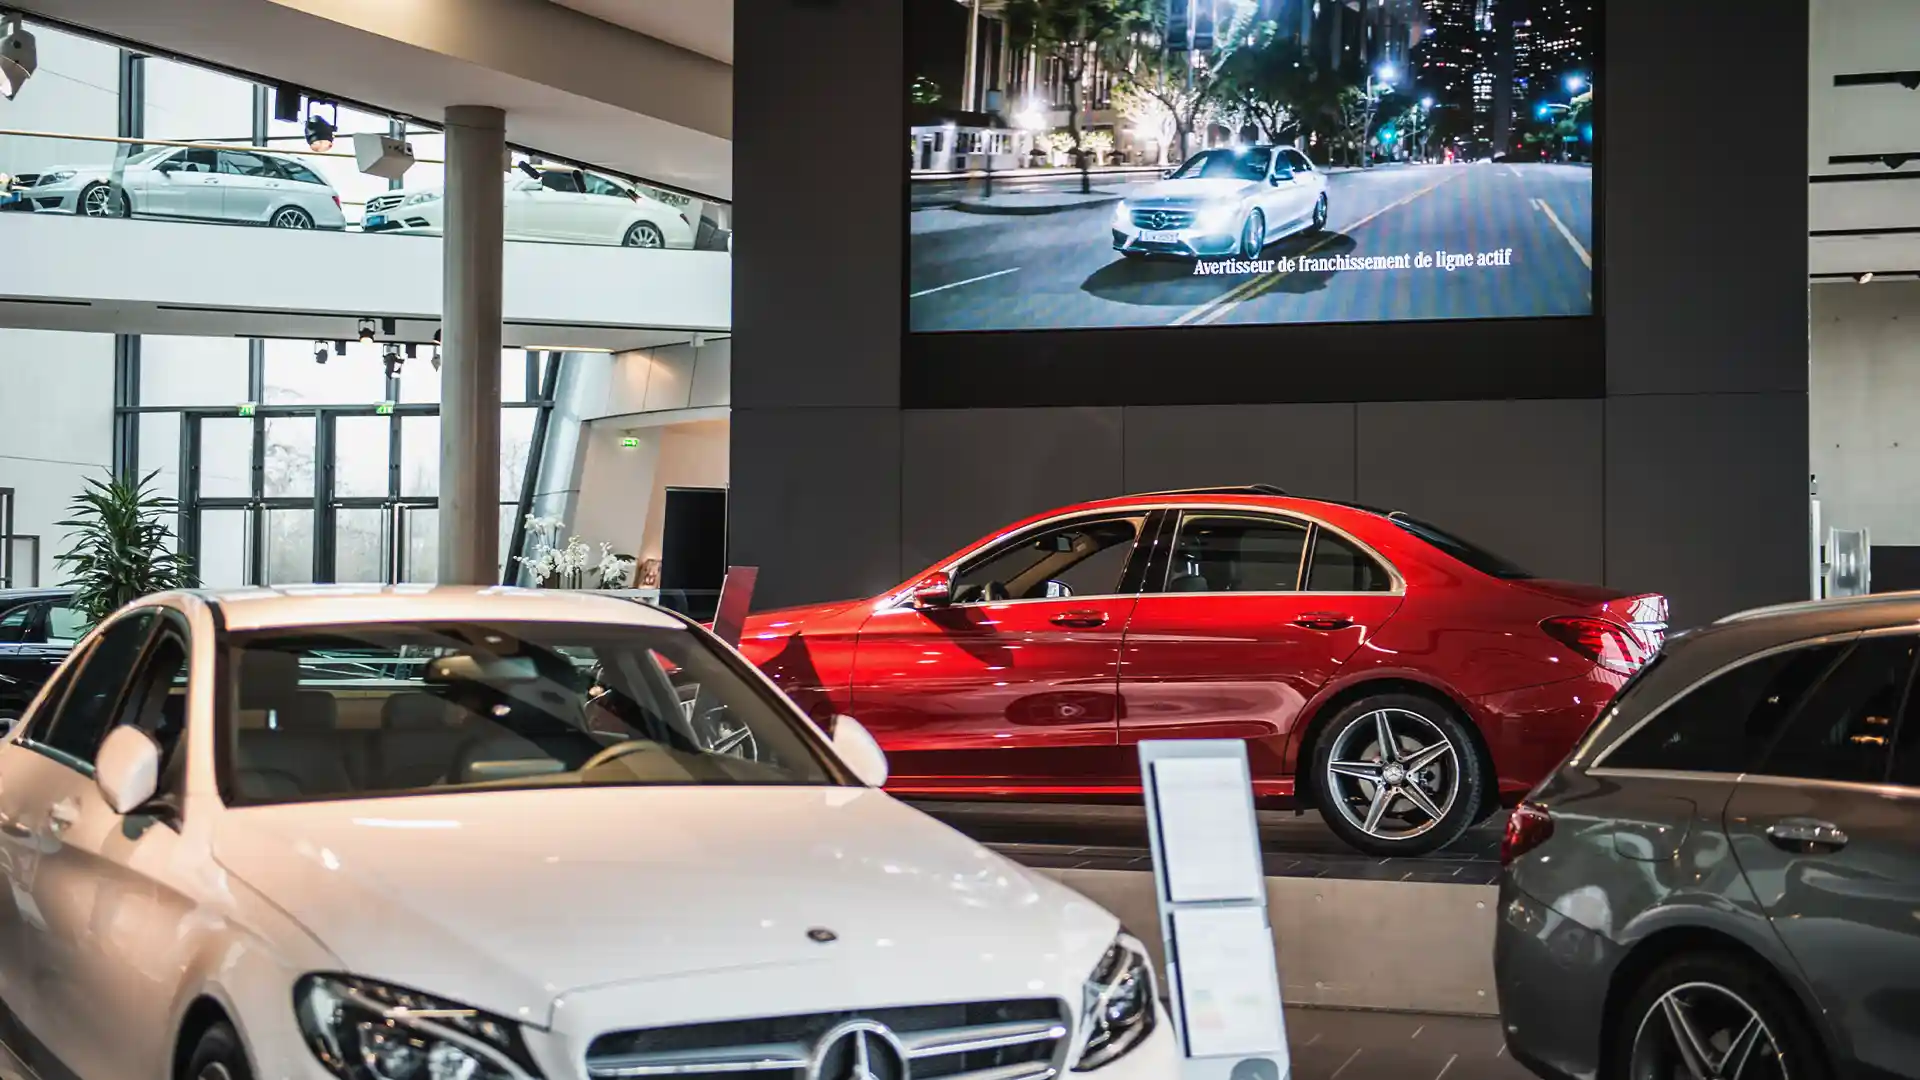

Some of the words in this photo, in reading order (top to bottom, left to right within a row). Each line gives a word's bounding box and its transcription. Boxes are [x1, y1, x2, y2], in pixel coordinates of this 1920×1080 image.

[1193, 258, 1274, 275] Avertisseur
[1278, 256, 1295, 272] de
[1299, 254, 1410, 272] franchissement
[1414, 251, 1433, 268] de
[1436, 250, 1473, 271] ligne
[1477, 248, 1512, 266] actif
